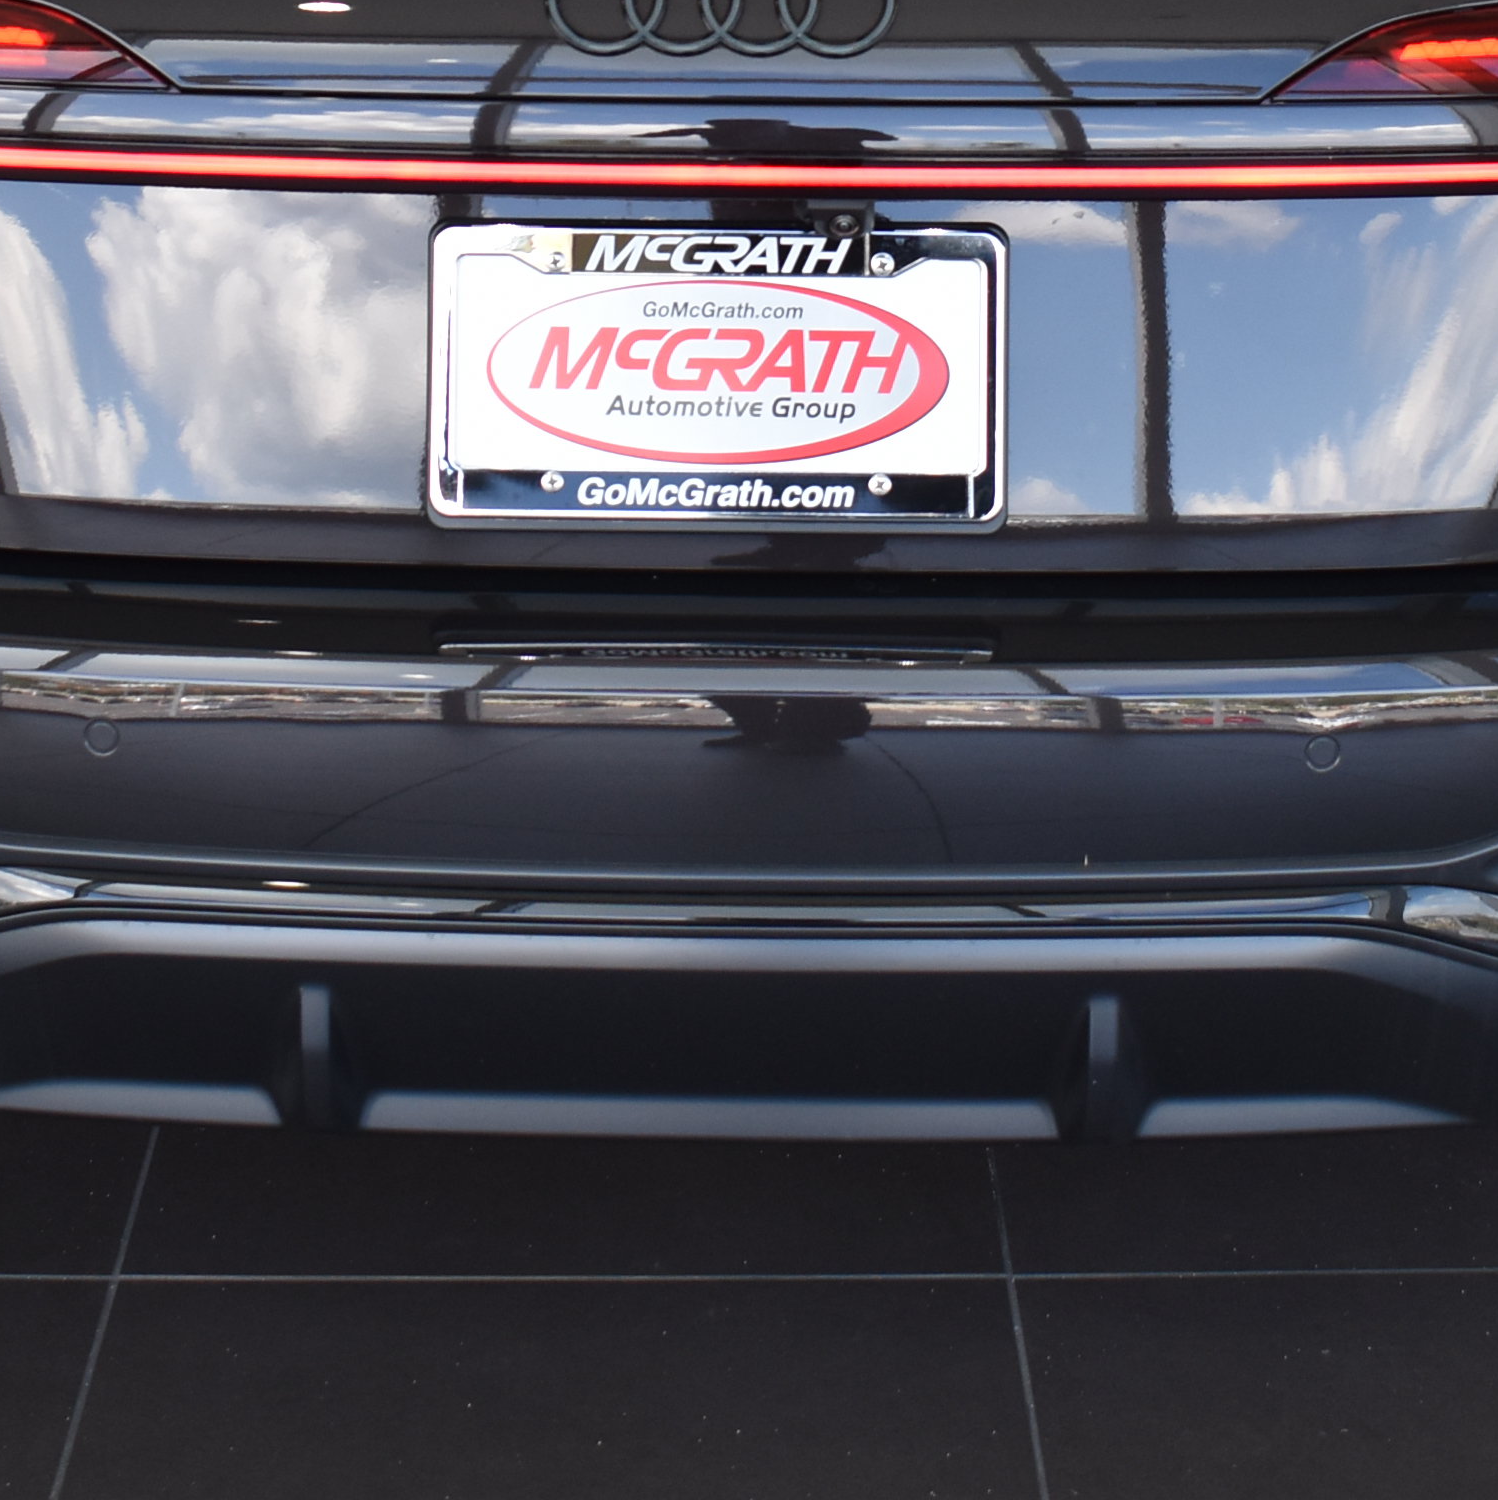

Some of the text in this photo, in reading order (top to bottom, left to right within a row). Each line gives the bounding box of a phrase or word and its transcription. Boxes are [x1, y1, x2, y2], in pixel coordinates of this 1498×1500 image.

[642, 301, 804, 320] GoMcGrath.com
[606, 396, 856, 424] Automotive Group
[577, 476, 856, 509] GoMcGrath.com
